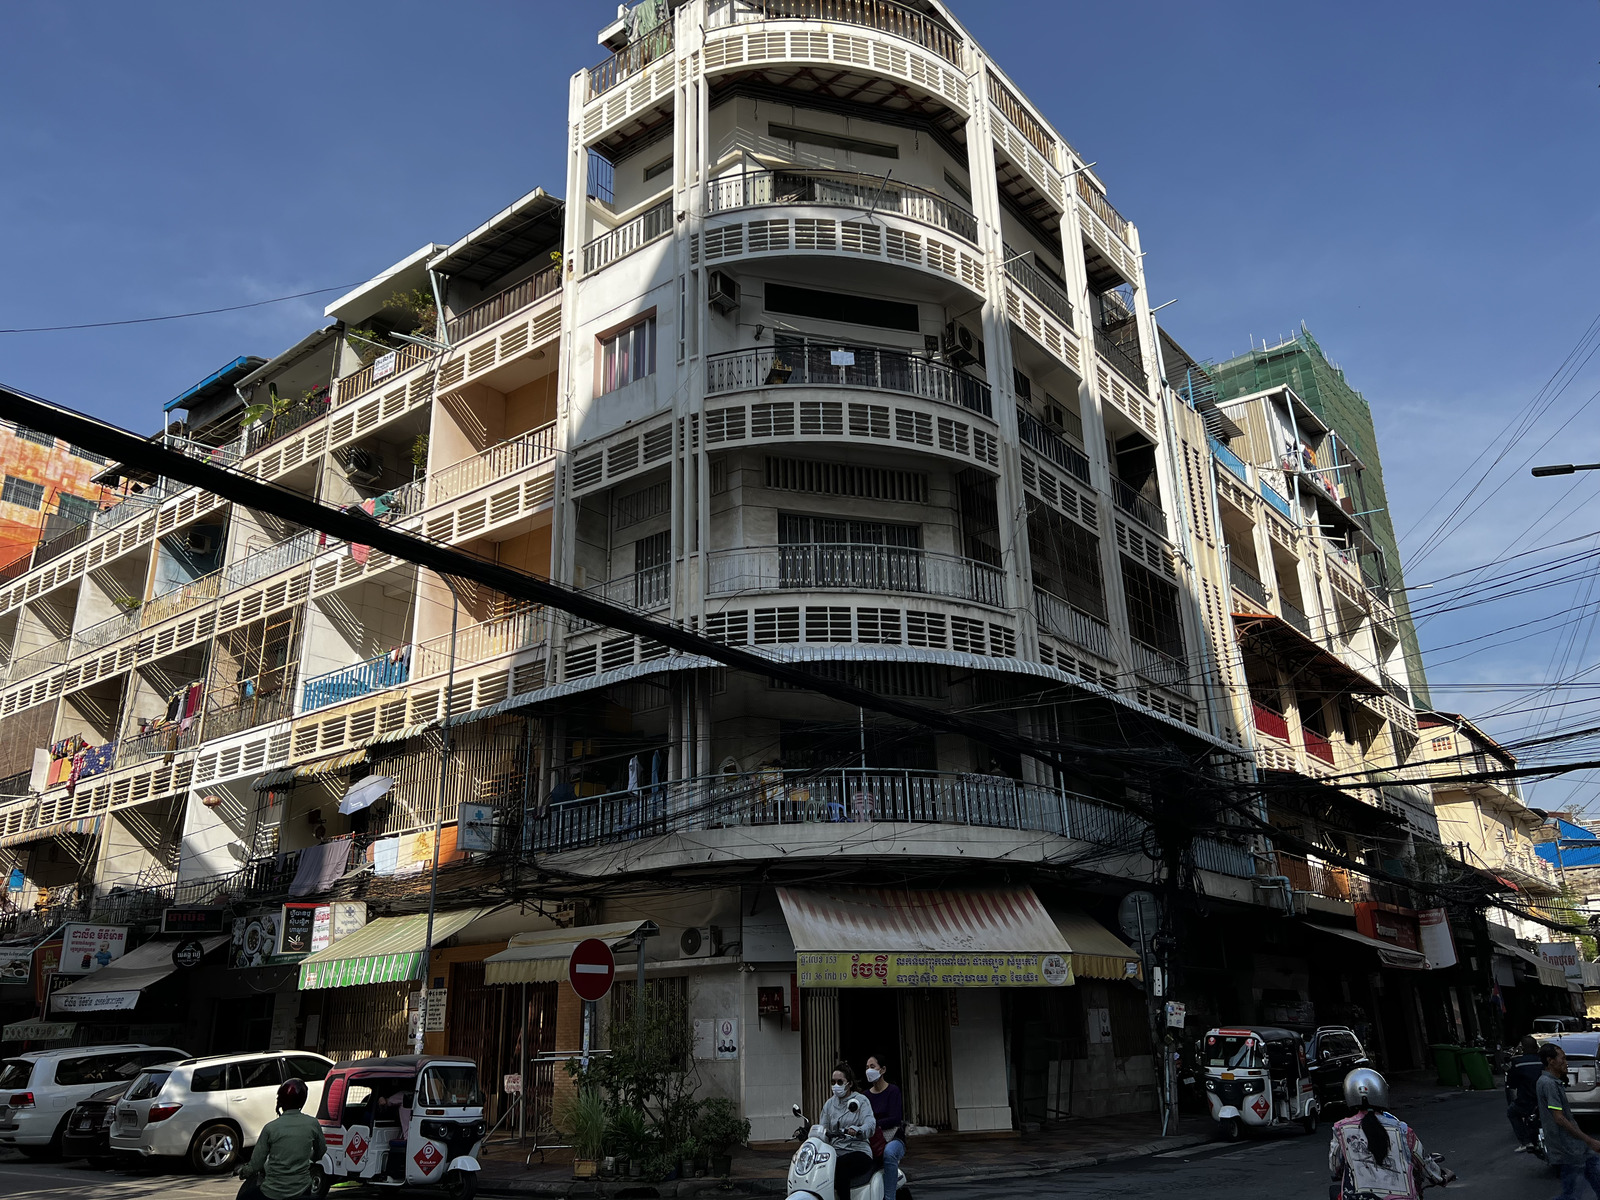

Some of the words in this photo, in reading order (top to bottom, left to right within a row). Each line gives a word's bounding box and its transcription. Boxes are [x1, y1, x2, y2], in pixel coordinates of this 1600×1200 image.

[825, 955, 837, 964] 153
[814, 972, 823, 980] 36
[839, 972, 848, 980] 19
